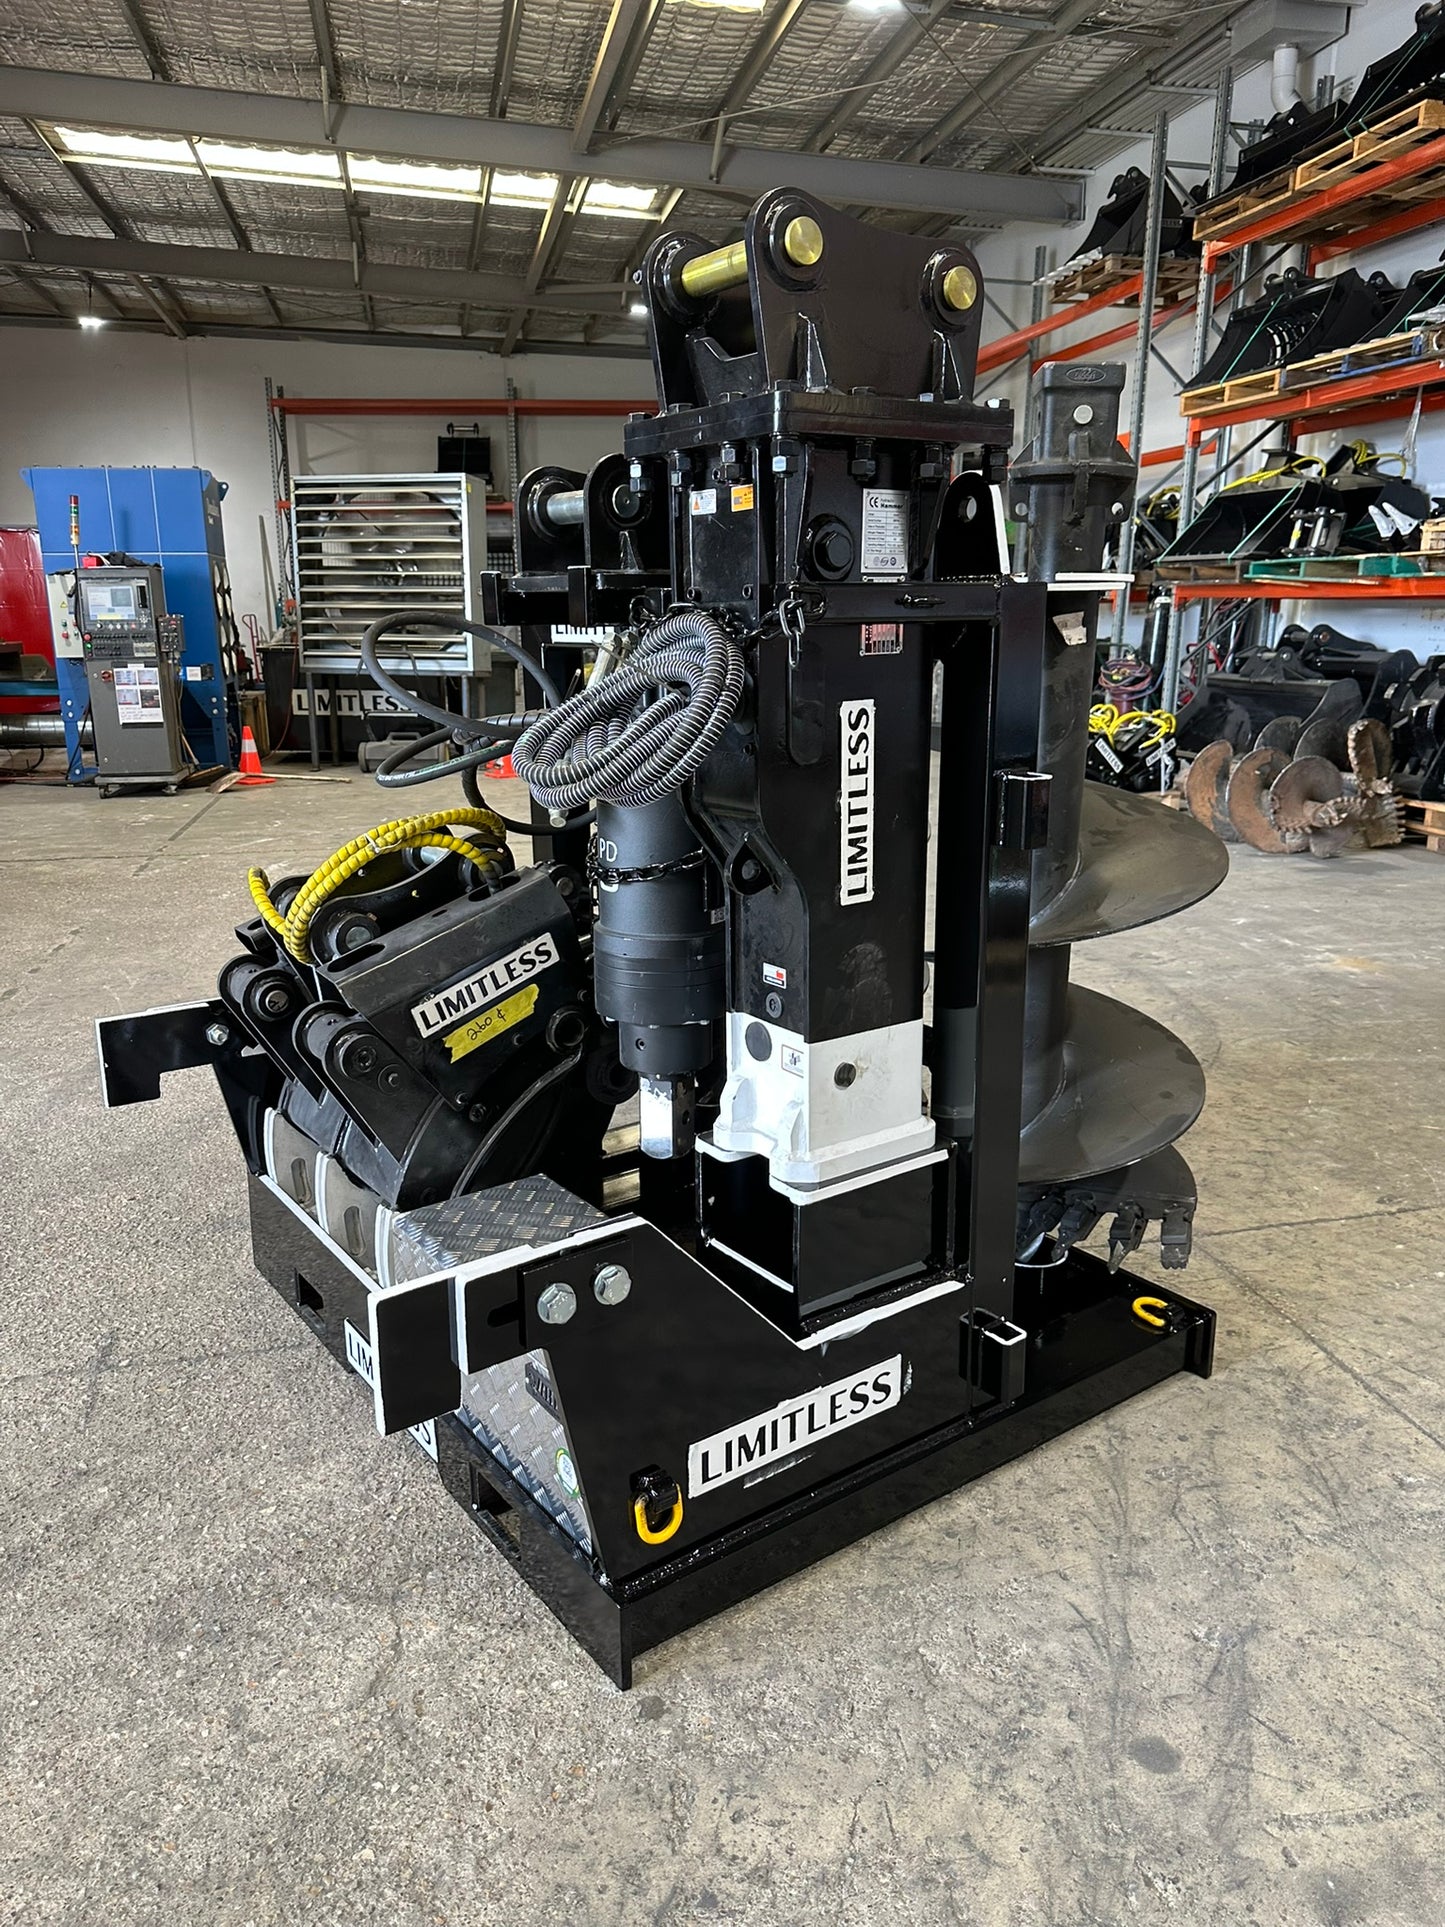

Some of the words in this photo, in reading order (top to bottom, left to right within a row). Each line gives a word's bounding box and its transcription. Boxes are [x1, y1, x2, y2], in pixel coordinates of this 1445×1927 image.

[296, 693, 412, 712] LMITLES
[847, 707, 870, 897] LIMITLESS
[600, 838, 618, 862] PD
[419, 942, 553, 1031] LIMITLESS
[701, 1371, 892, 1485] LIMITLESS
